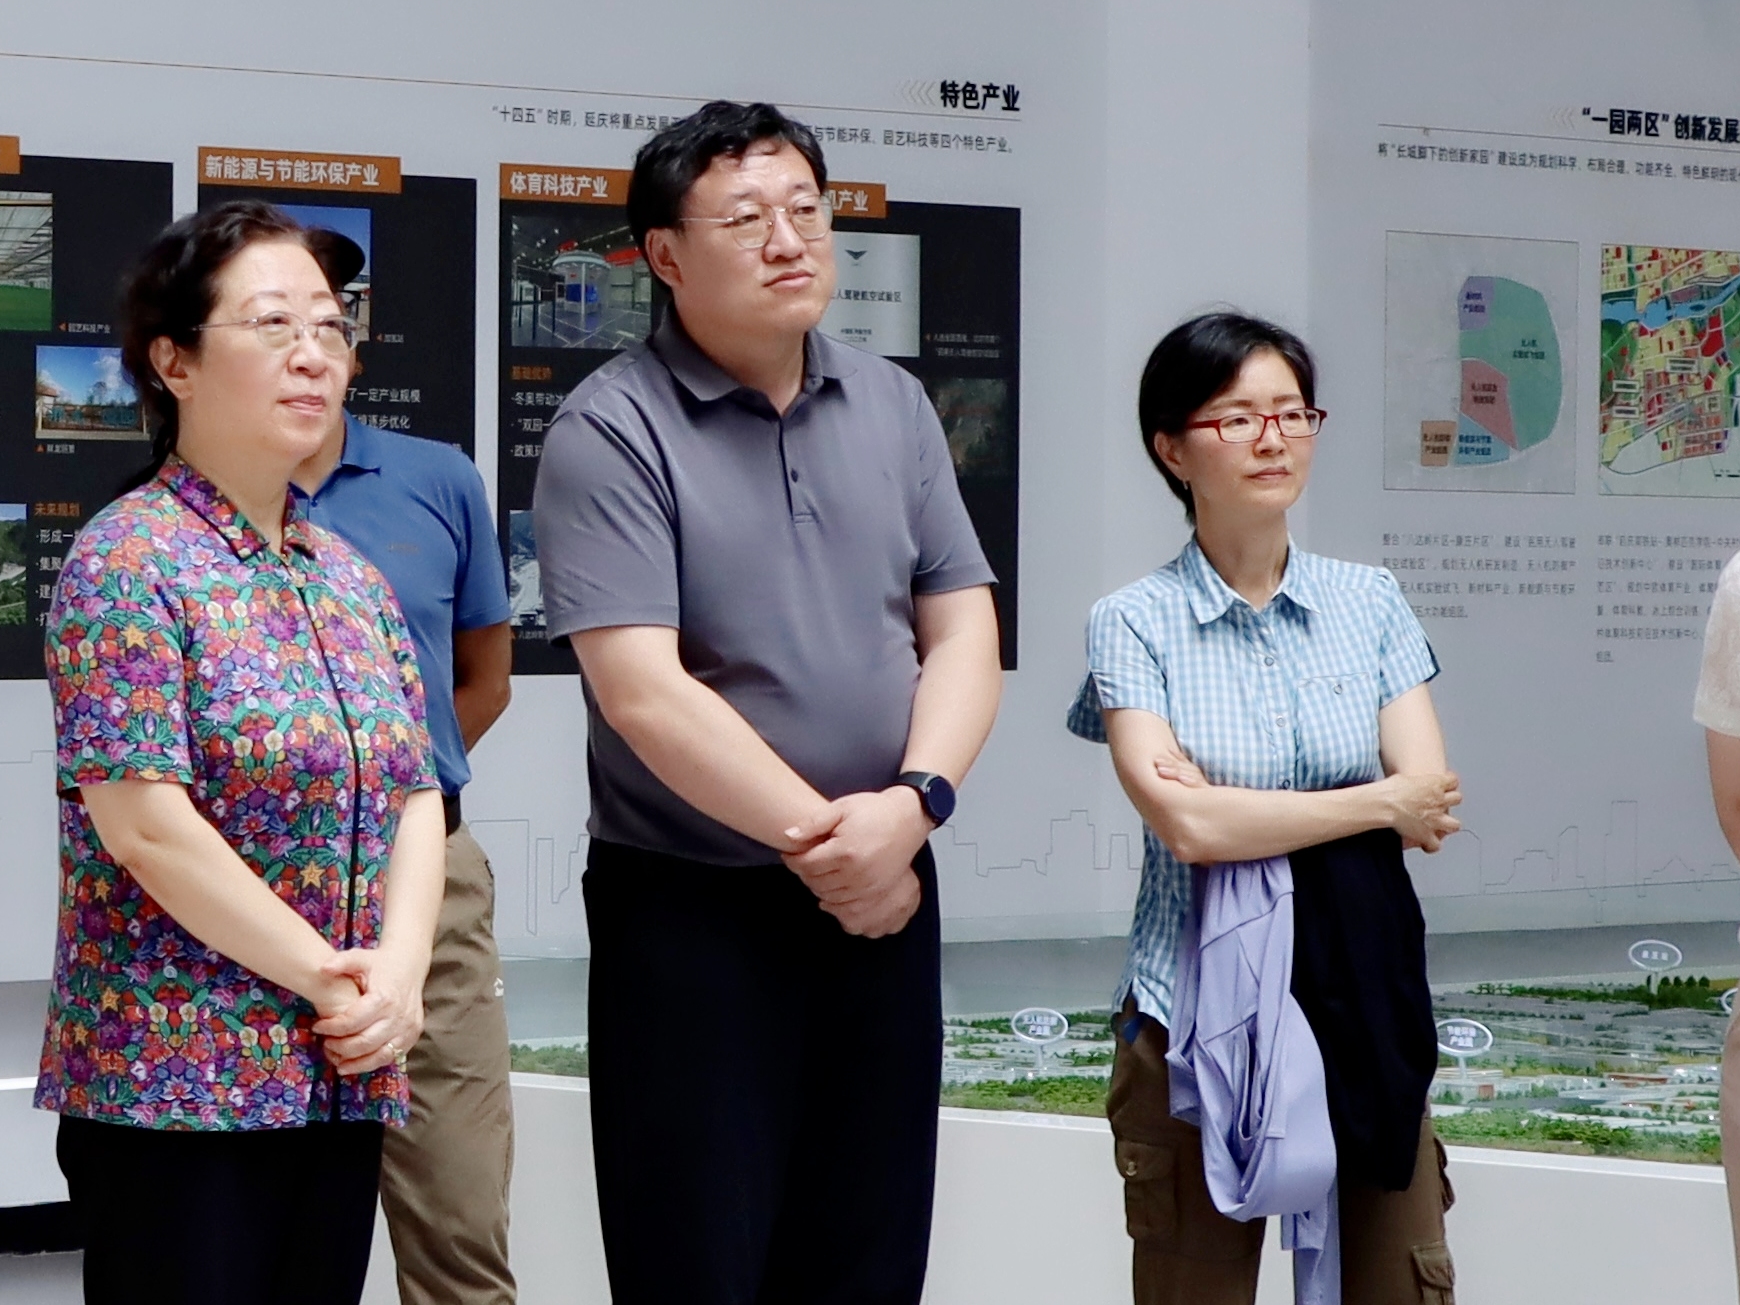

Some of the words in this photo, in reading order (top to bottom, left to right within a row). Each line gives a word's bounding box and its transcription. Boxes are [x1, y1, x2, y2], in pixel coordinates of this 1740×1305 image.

[940, 80, 1020, 112] 特色产业
[805, 126, 1013, 153] 与节能环保、园艺科技等四个特色产业。
[205, 154, 379, 186] 新能源与节能环保产业
[510, 172, 608, 198] 体育科技产业
[832, 289, 901, 303] 人驾驶航空试验区
[344, 388, 421, 403] 了一定产业规模
[39, 529, 76, 544] 形成一
